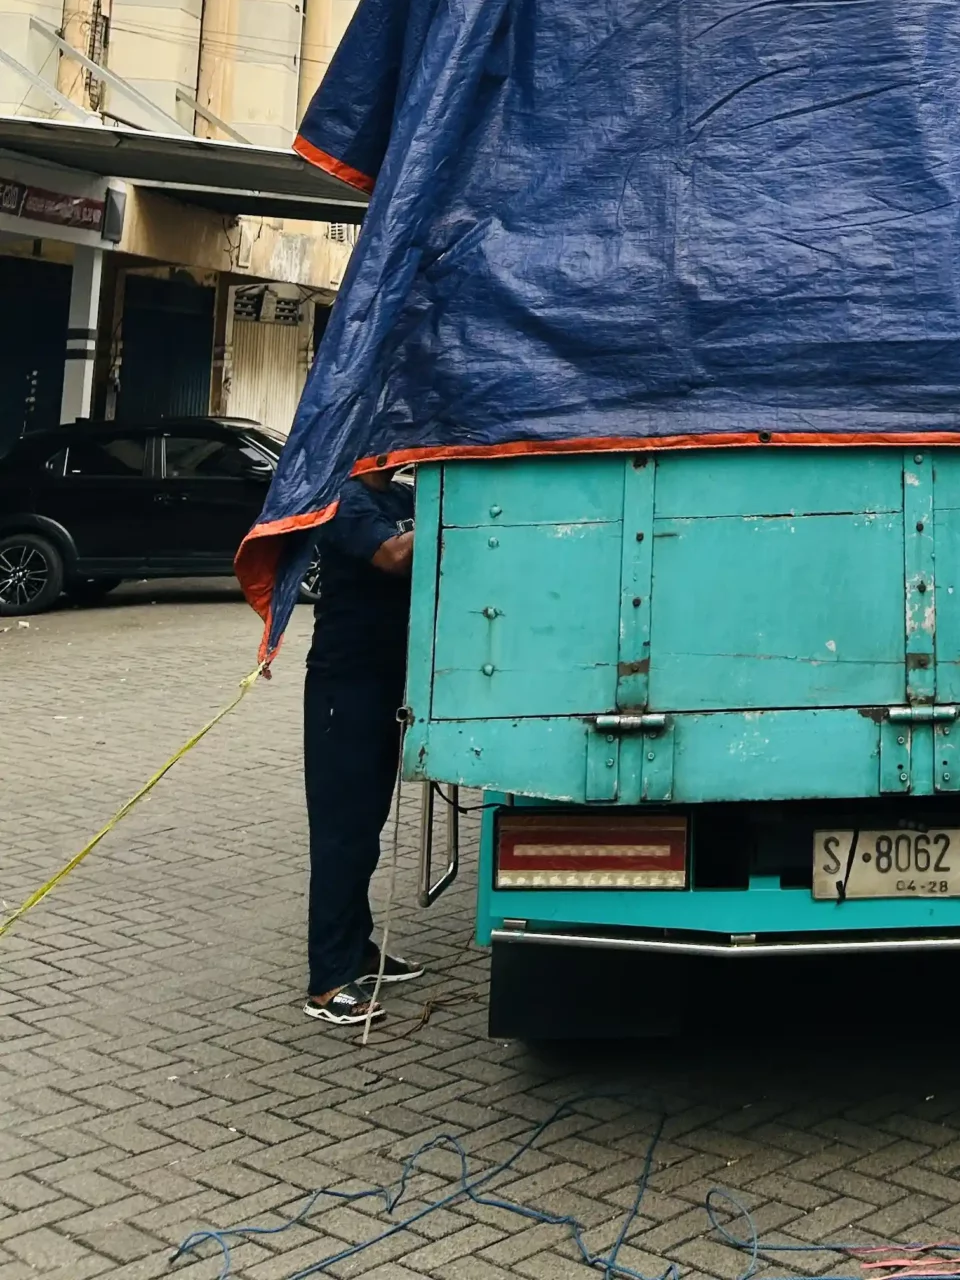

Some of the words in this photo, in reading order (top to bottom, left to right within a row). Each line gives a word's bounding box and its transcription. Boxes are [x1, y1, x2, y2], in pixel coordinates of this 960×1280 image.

[823, 836, 841, 874] S
[875, 833, 951, 873] 8062
[896, 880, 949, 892] 04-28
